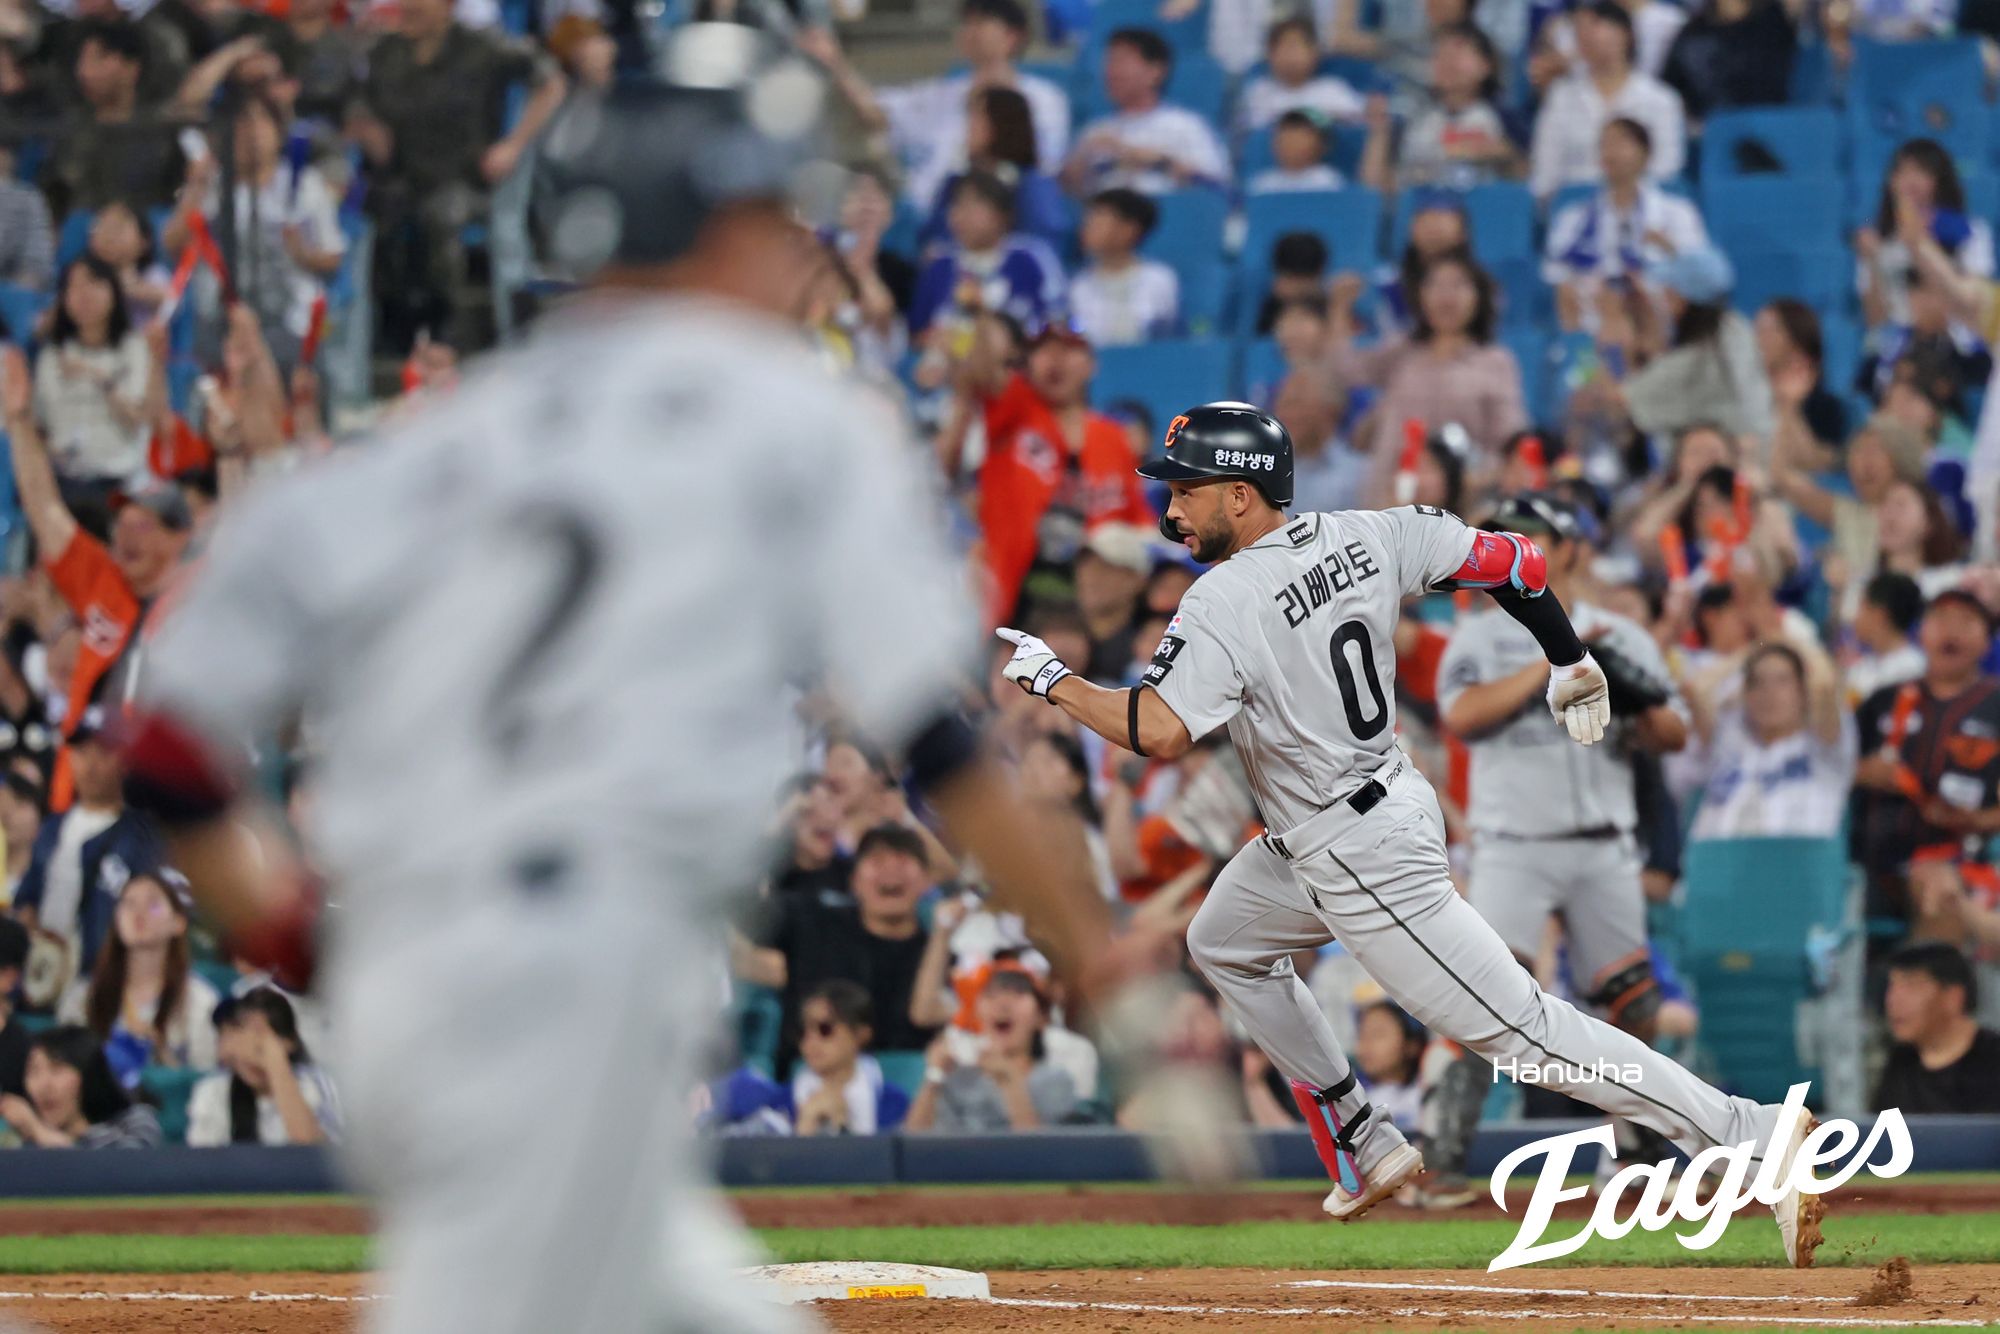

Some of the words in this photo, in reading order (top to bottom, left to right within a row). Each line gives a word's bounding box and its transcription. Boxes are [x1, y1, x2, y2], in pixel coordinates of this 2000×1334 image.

[1214, 449, 1275, 471] 한화생명
[1274, 540, 1380, 630] 리베라토
[1040, 668, 1054, 680] 18
[1329, 620, 1389, 741] 0
